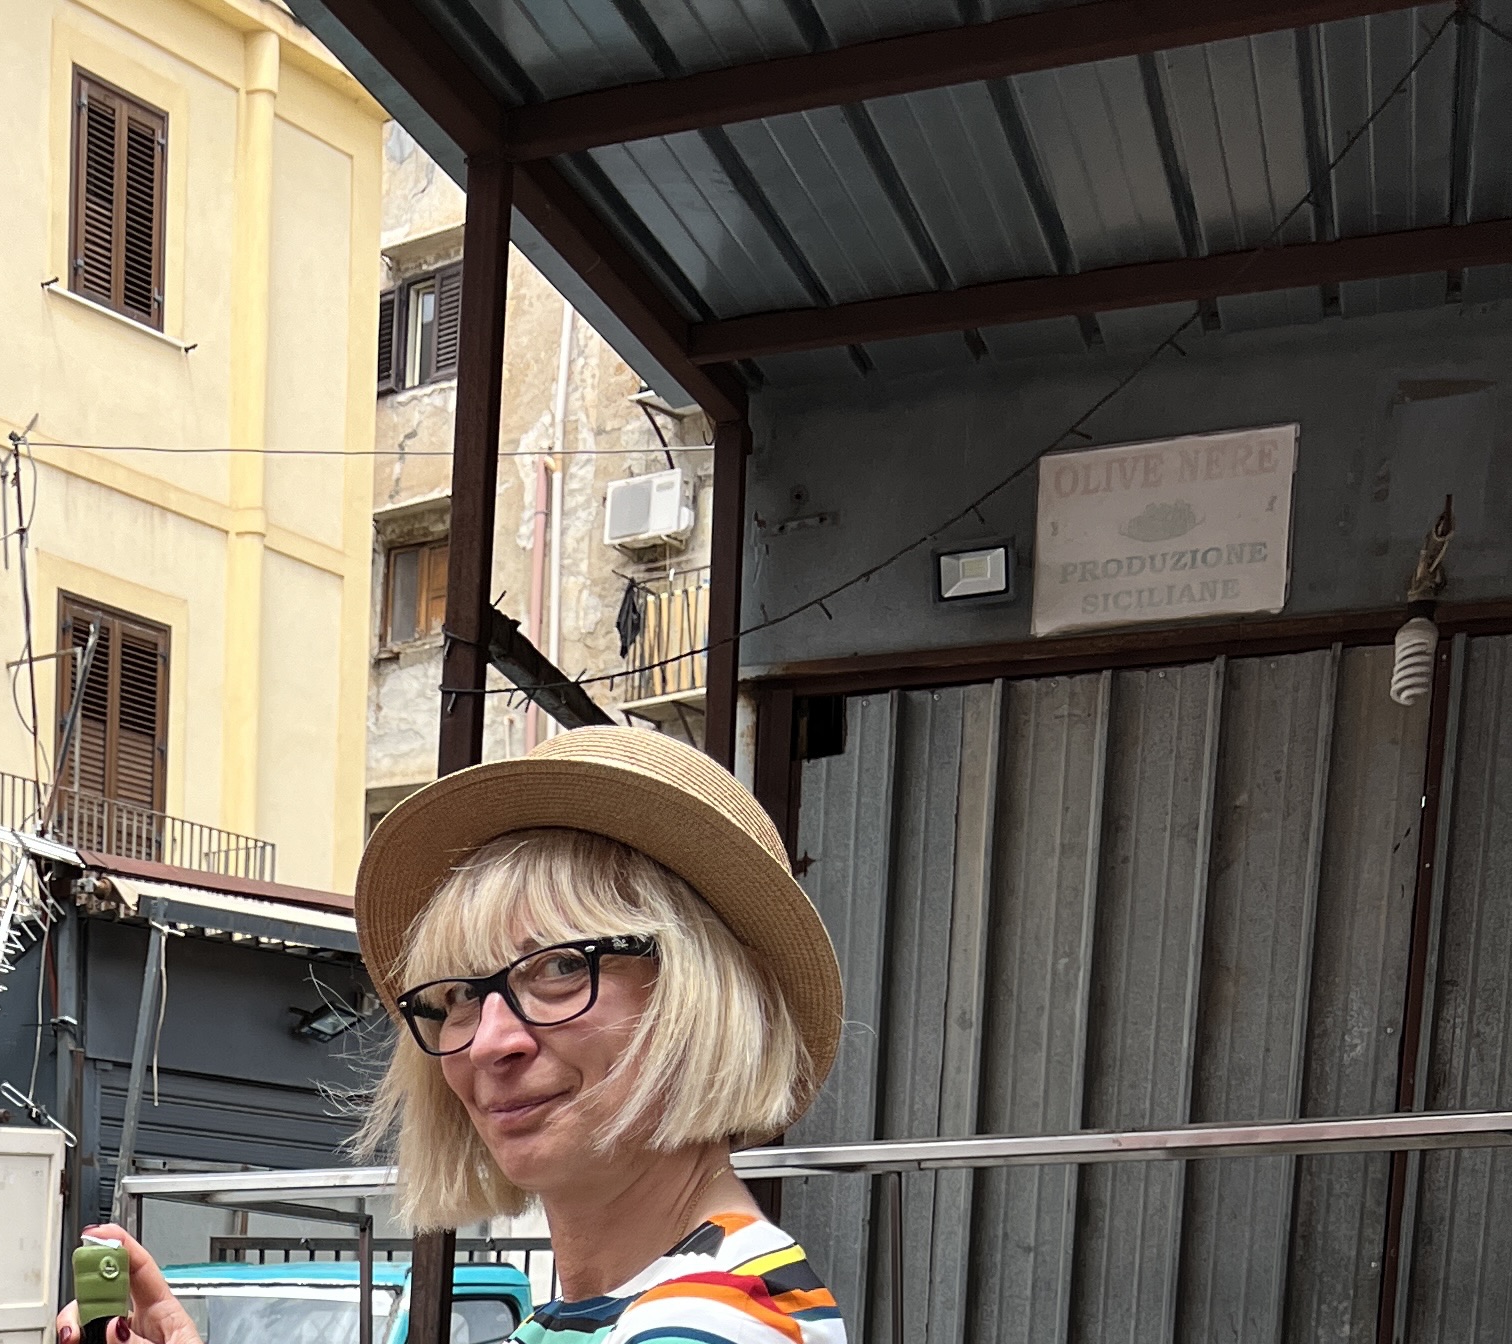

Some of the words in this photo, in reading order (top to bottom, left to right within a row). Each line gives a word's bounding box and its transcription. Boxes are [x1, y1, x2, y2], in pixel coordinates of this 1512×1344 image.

[1054, 452, 1165, 499] OLIVE
[1178, 438, 1279, 484] NERE
[1059, 541, 1269, 585] PRODUZIONE
[1081, 578, 1241, 615] SICILIANE
